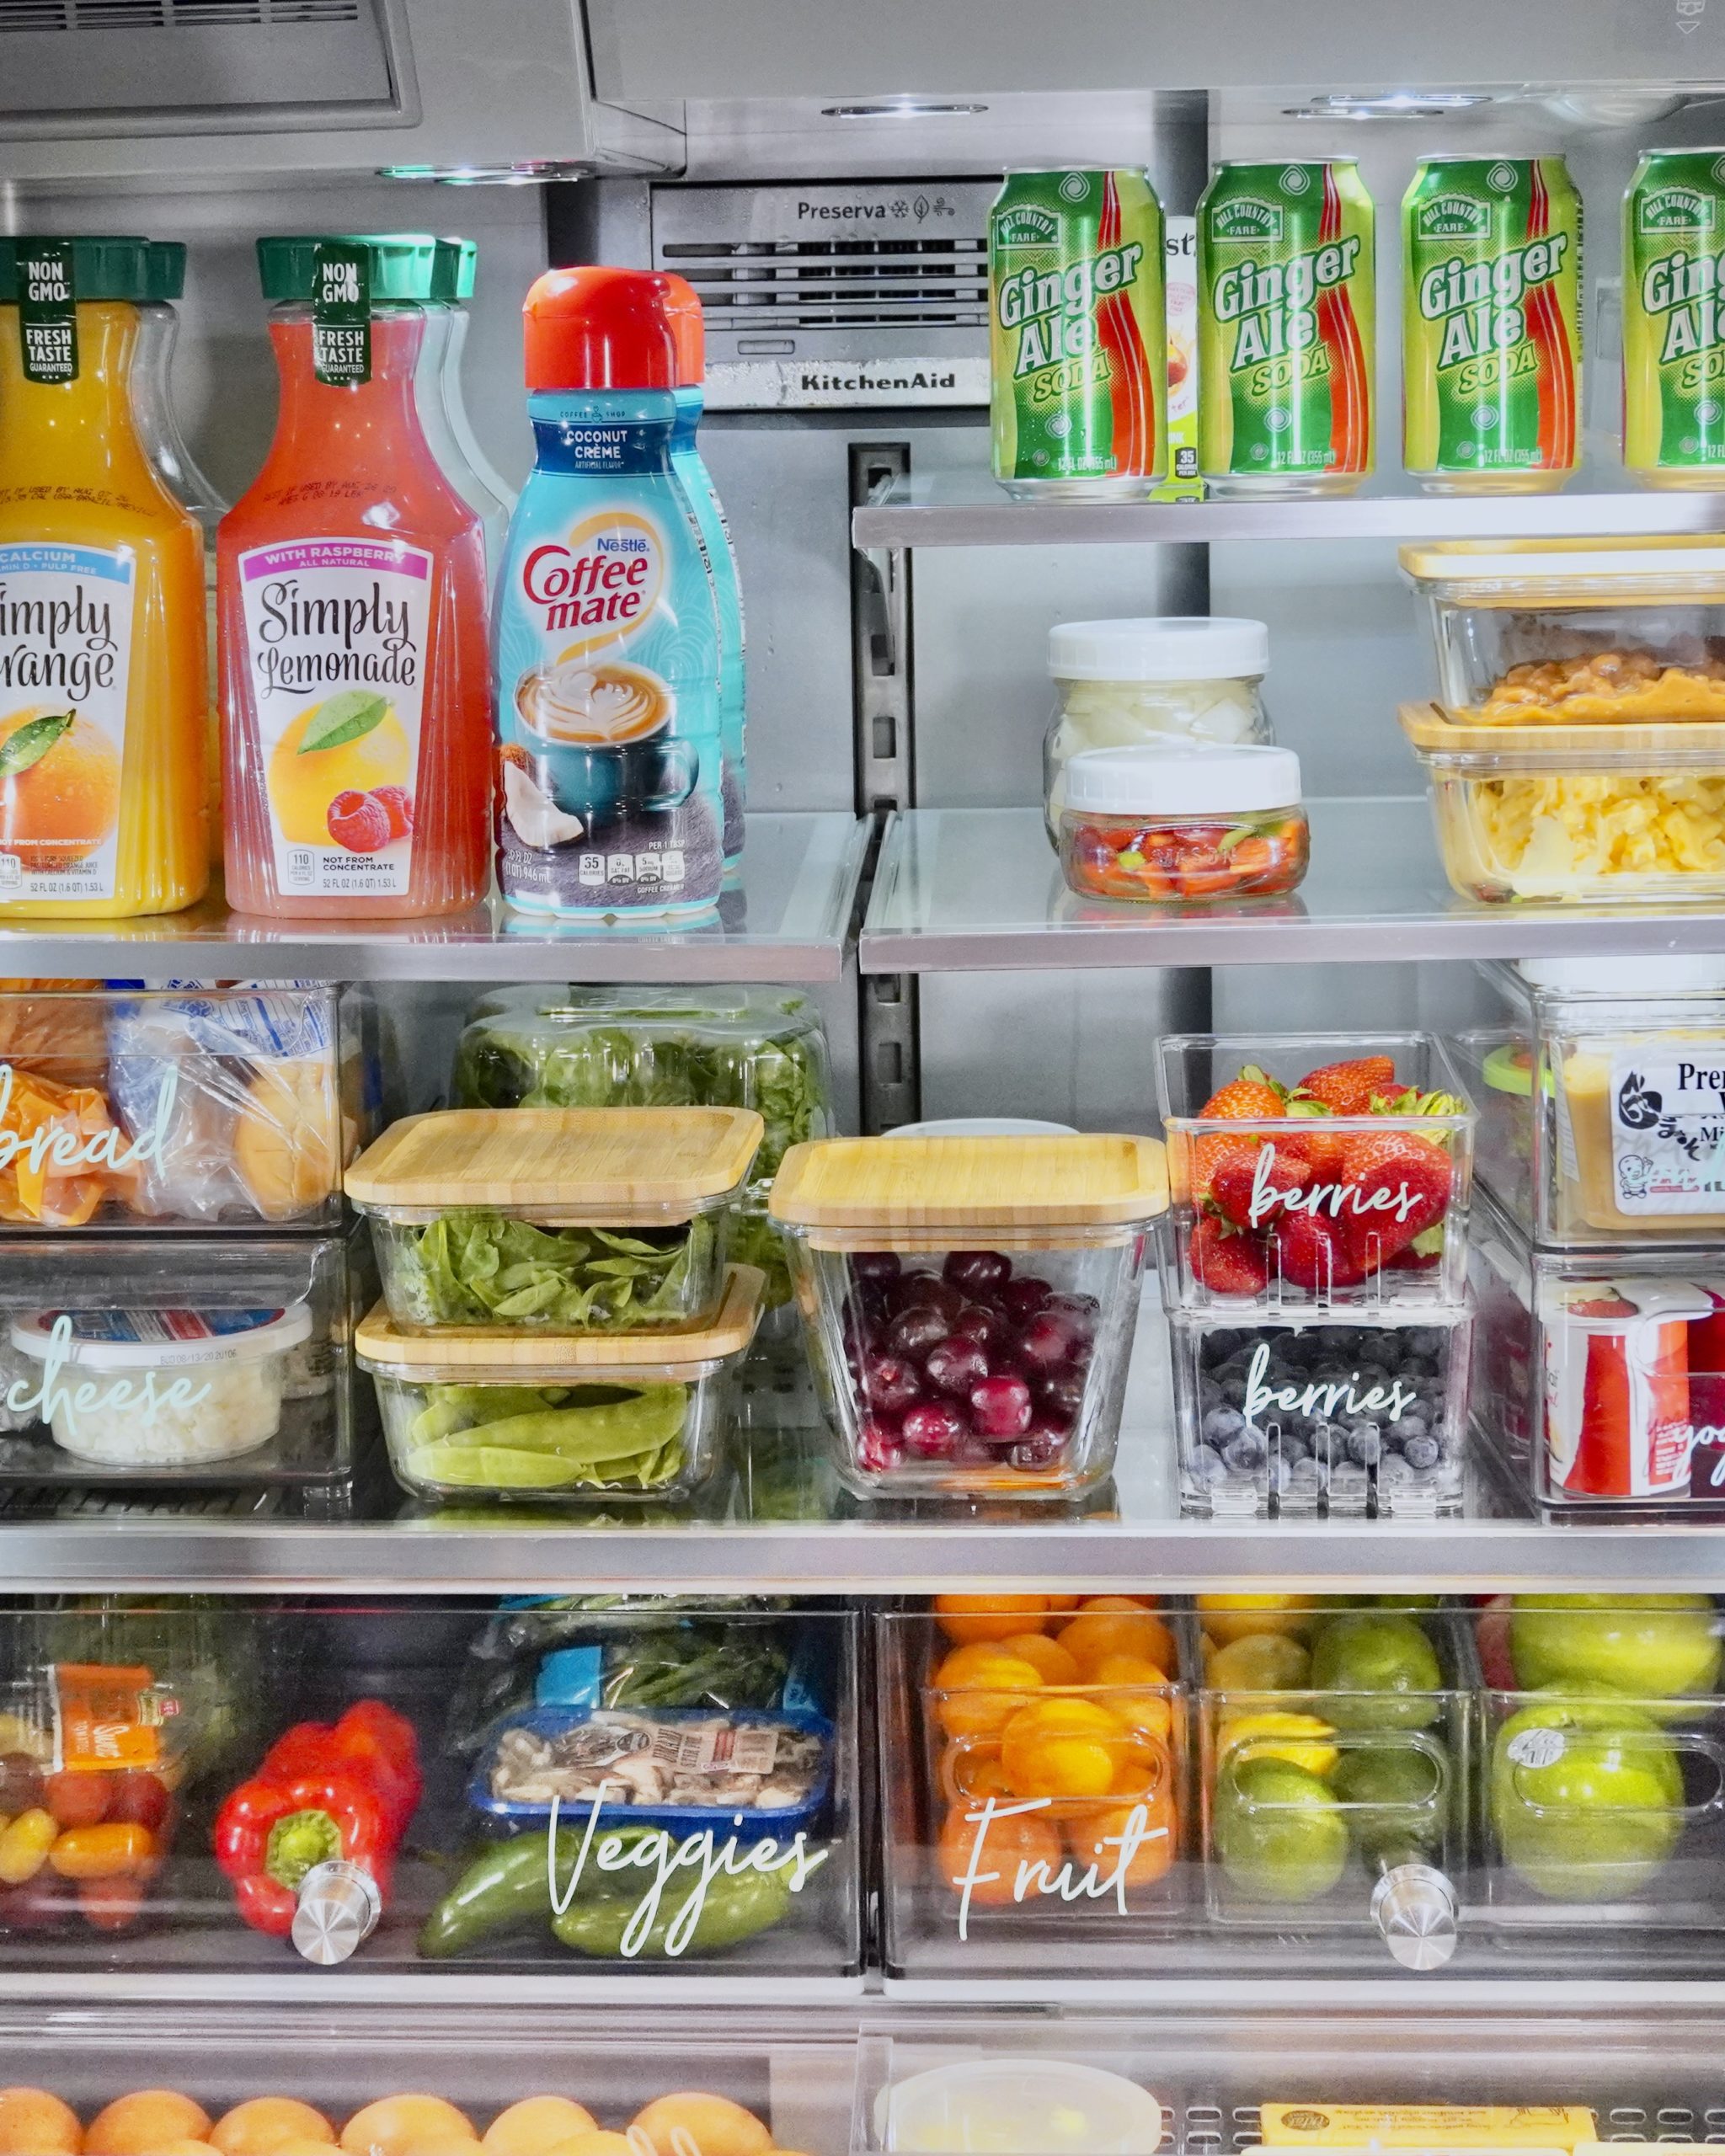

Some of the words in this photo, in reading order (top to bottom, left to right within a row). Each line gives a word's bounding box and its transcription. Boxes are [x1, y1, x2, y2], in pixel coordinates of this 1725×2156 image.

[798, 201, 886, 219] Preserva
[1216, 209, 1233, 229] HILL
[1234, 205, 1277, 228] COUNTRY
[1423, 205, 1441, 227] HILL
[1441, 201, 1484, 226] COUNTRY
[1646, 198, 1664, 220] HILL
[1016, 211, 1055, 235] COUNTRY
[1435, 223, 1465, 233] FARE
[1658, 216, 1688, 227] FARE
[1012, 232, 1037, 243] FARE
[1230, 226, 1258, 236] FARE
[1166, 232, 1196, 256] st
[28, 262, 63, 280] NON
[323, 263, 357, 281] NON
[1215, 236, 1359, 322] Ginger
[1421, 232, 1567, 319] Ginger
[29, 282, 65, 302] GMO
[323, 283, 359, 302] GMO
[1001, 243, 1141, 328] Ginger
[26, 329, 72, 345] FRESH
[319, 330, 364, 346] FRESH
[1017, 312, 1097, 376] Ale
[1231, 308, 1317, 373] Ale
[1437, 303, 1525, 371] Ale
[28, 346, 72, 362] TASTE
[320, 347, 363, 363] TASTE
[29, 363, 72, 372] GUARANTEED
[322, 364, 365, 373] GUARANTEED
[1033, 347, 1111, 402] SODA
[1252, 344, 1332, 397] SODA
[1459, 341, 1537, 396] SODA
[1683, 354, 1725, 389] SO
[801, 373, 955, 390] KitchenAid
[566, 430, 628, 443] COCONUT
[1167, 432, 1185, 445] INK
[574, 443, 622, 459] CRÈME
[1180, 451, 1194, 463] 35
[1484, 450, 1493, 462] 12
[1708, 444, 1717, 458] 12
[0, 551, 76, 563] CALCIUM
[264, 547, 306, 565] WITH
[310, 547, 406, 564] RASPBERRY
[321, 558, 370, 568] NATURAL
[71, 565, 97, 574] FREE
[523, 544, 649, 605] Coffee
[0, 582, 118, 652] imply
[259, 579, 417, 652] Simply
[546, 591, 640, 632] mate
[0, 644, 115, 702] range
[257, 643, 415, 700] Lemonade
[649, 841, 663, 850] PER
[670, 839, 686, 848] TBSP
[293, 854, 309, 865] 110
[585, 857, 599, 869] 35
[323, 878, 330, 889] 52
[332, 879, 340, 889] FL
[341, 879, 350, 889] OZ
[351, 879, 364, 889] (1.6
[365, 879, 376, 889] QT)
[377, 878, 391, 889] 1.53
[392, 878, 397, 888] L
[523, 866, 538, 882] 946
[538, 867, 552, 883] mL
[30, 883, 39, 893] 52
[40, 883, 47, 893] FL
[49, 883, 57, 893] OZ
[58, 883, 71, 894] (1.6
[72, 883, 83, 894] QT)
[85, 883, 98, 893] 1.53
[99, 883, 104, 892] L
[637, 885, 658, 894] COFFEE
[1677, 1063, 1725, 1091] Pre
[1248, 1143, 1423, 1229] berries
[7, 1314, 212, 1435] cheese
[1242, 1343, 1417, 1428] berries
[548, 1778, 829, 1958] Veggies
[952, 1796, 1169, 1941] Fruit
